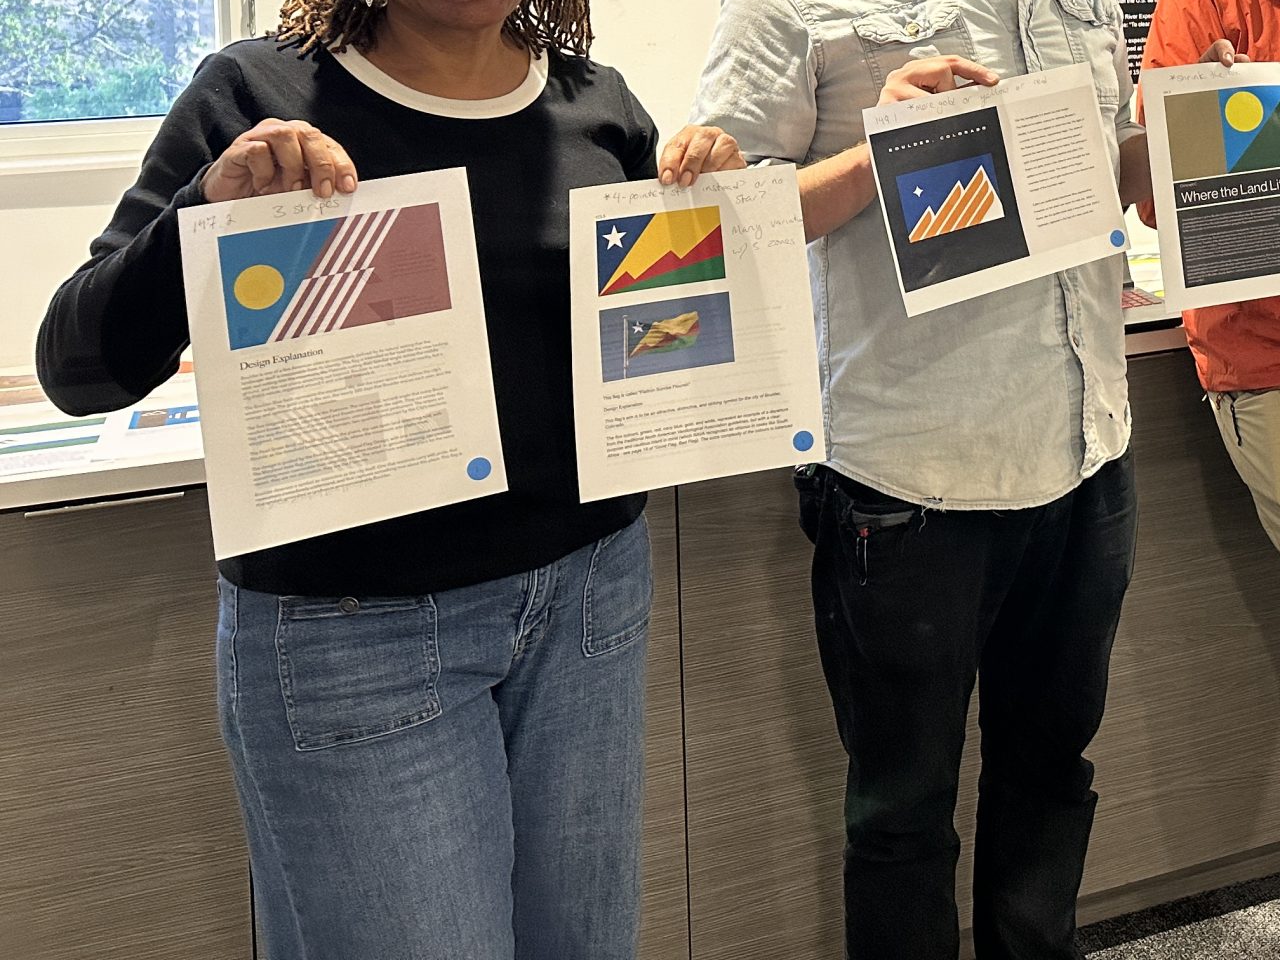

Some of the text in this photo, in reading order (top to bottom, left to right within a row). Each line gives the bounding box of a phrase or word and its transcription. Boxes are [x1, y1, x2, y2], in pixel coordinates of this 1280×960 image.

[940, 126, 987, 140] COLORADO
[1181, 190, 1218, 203] Where
[1220, 187, 1238, 197] the
[1240, 181, 1267, 195] Land
[272, 205, 287, 218] 3
[240, 349, 323, 370] Design Explanation
